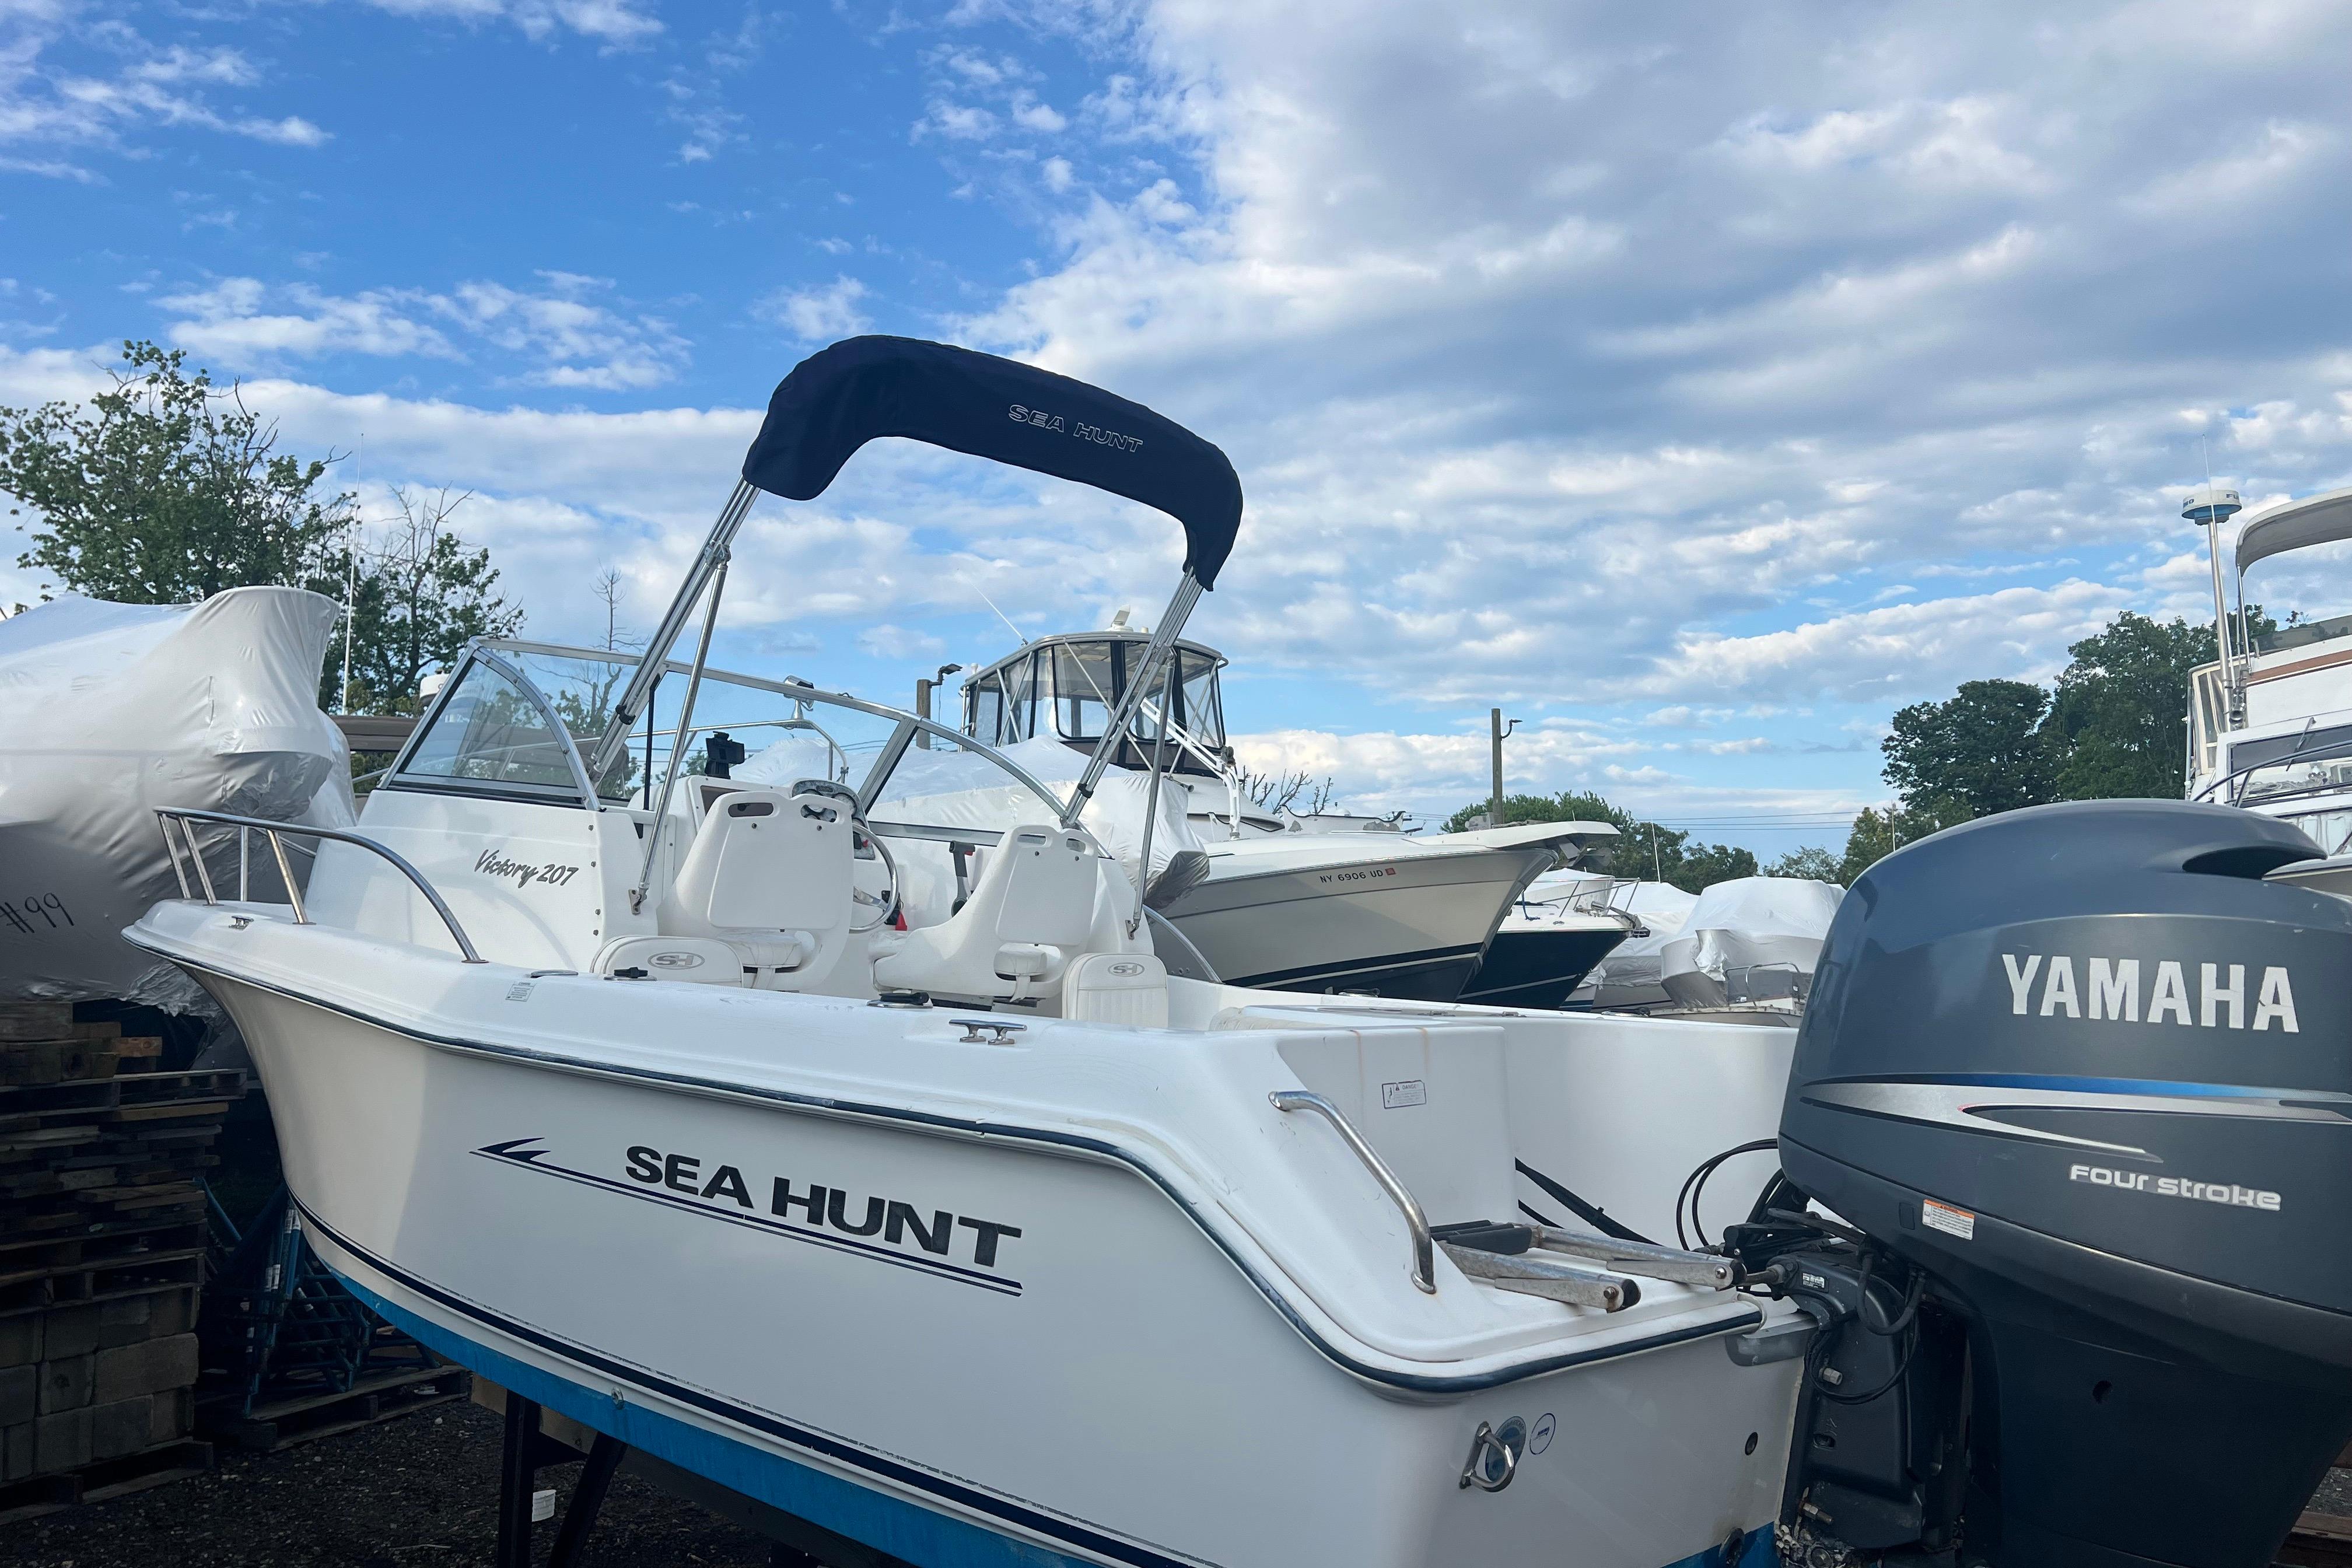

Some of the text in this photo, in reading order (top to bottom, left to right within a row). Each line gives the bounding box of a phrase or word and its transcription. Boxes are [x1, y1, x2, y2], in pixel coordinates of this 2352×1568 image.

[1009, 404, 1143, 453] SEA HUNT
[474, 849, 579, 888] Victory 207
[1320, 875, 1332, 883] NY
[1338, 872, 1366, 881] 6906
[1370, 870, 1383, 878] UD
[0, 892, 74, 933] #99
[654, 955, 694, 966] SH
[2002, 954, 2300, 1033] YAMAHA
[625, 1146, 1022, 1268] SEA HUNT
